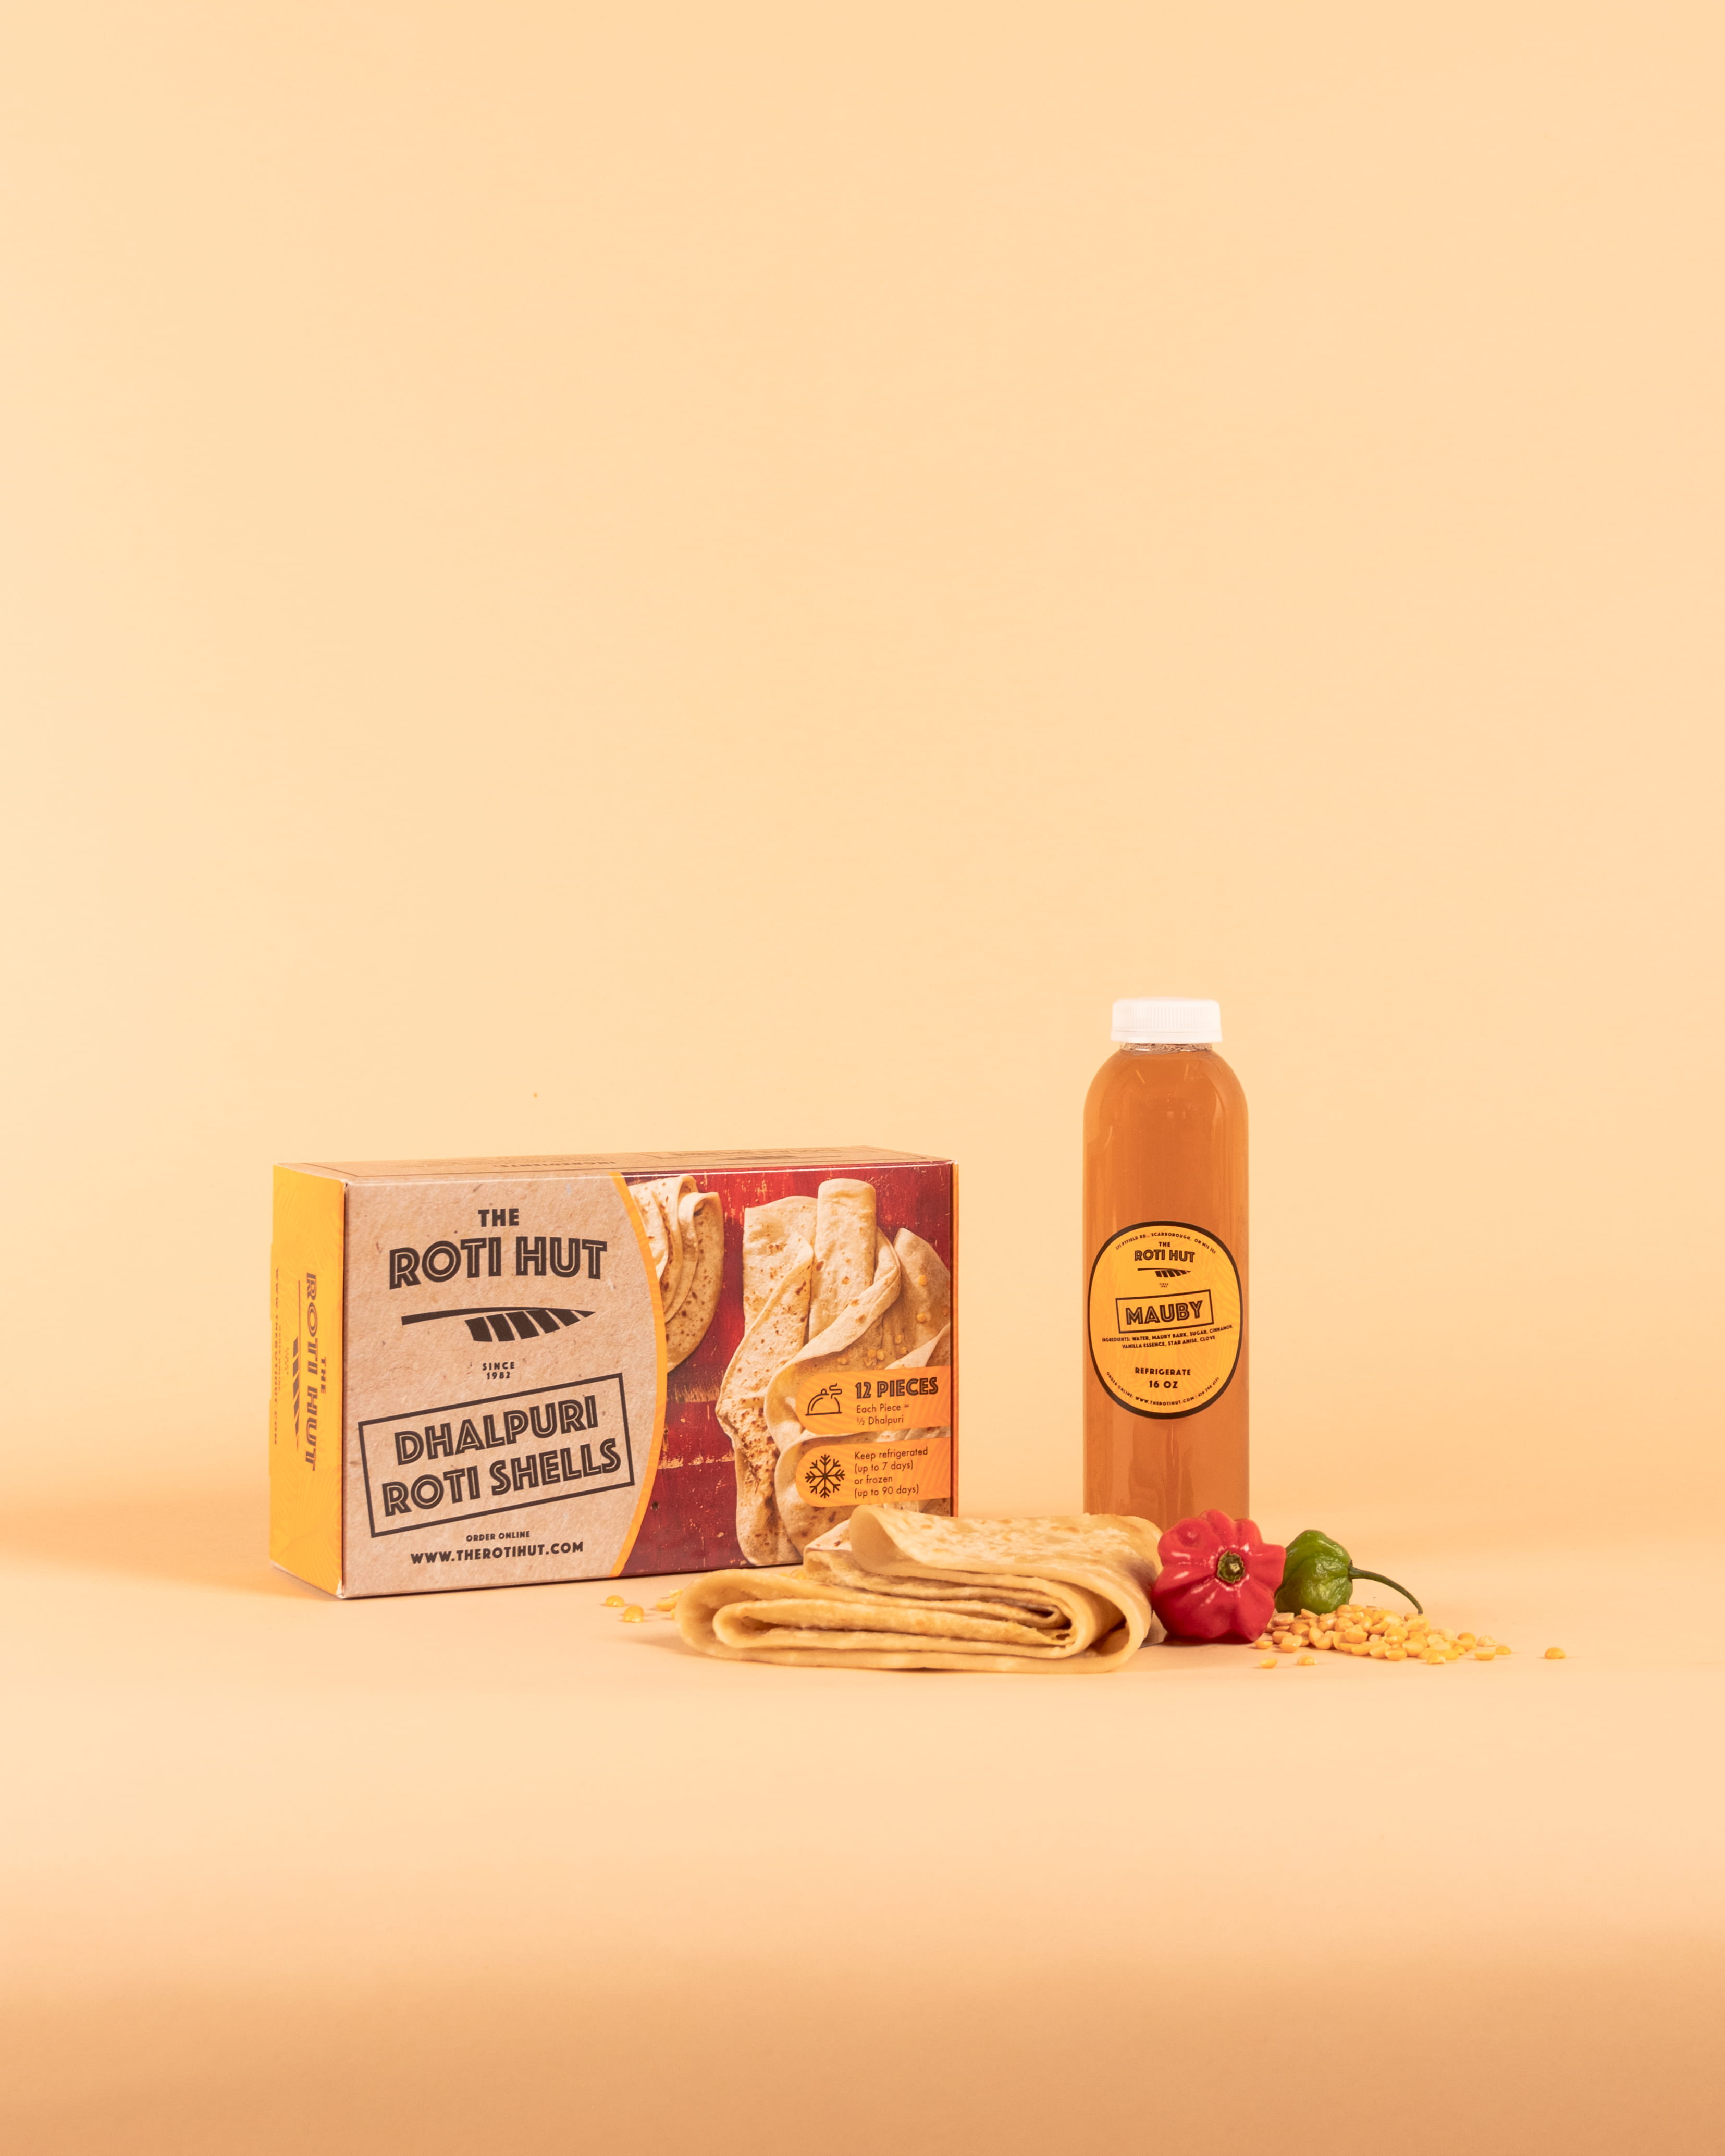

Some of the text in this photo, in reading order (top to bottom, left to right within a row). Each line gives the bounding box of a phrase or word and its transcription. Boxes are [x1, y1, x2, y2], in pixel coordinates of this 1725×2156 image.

[478, 1208, 519, 1227] THE
[389, 1236, 607, 1289] ROTI HUT
[1135, 1249, 1195, 1262] ROTI HUT
[1125, 1300, 1203, 1325] MAUBY
[305, 1273, 318, 1471] ROTI HUT
[483, 1362, 514, 1371] SINCE
[1135, 1367, 1191, 1376] REFRIGERATE
[855, 1377, 939, 1399] 12 PIECES
[1149, 1380, 1178, 1389] 16 OZ
[857, 1404, 877, 1413] Each
[880, 1403, 901, 1411] Piece
[868, 1415, 904, 1425] Dhalpuri
[394, 1394, 598, 1465] DHALPURI
[855, 1447, 928, 1462] Keep refrigerated
[855, 1463, 868, 1474] (up
[891, 1460, 913, 1470] days)
[381, 1438, 622, 1517] ROTI SHELLS
[866, 1475, 893, 1484] frozen
[855, 1488, 868, 1499] (up
[896, 1484, 919, 1495] days)
[499, 1531, 529, 1539] ONLINE
[411, 1542, 583, 1564] WWW.THEROTIHUT.COM
